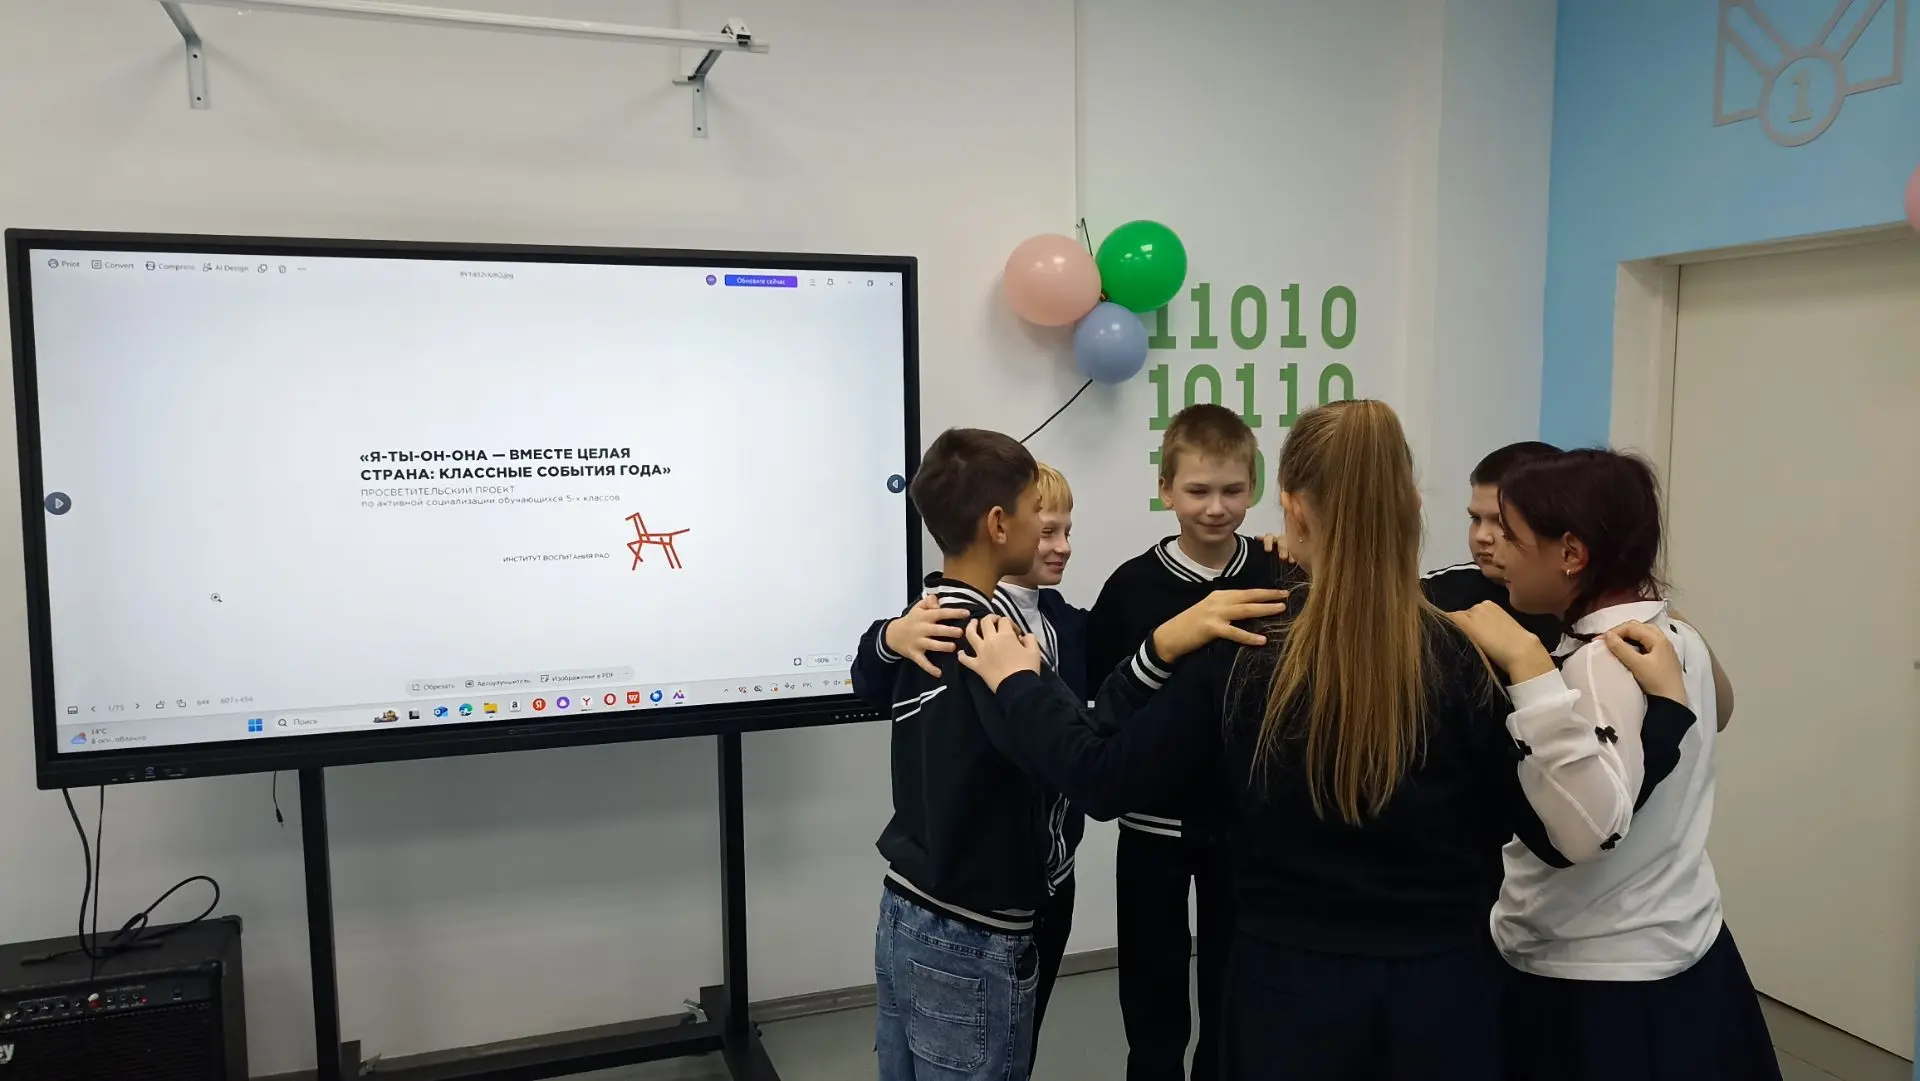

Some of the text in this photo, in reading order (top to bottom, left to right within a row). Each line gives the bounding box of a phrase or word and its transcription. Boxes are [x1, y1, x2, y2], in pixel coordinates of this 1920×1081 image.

[1787, 67, 1814, 124] 1
[61, 260, 80, 268] Print
[104, 261, 135, 269] Convert
[360, 449, 488, 462] «Я-ТЫ-ОН-ОНА
[509, 448, 573, 460] ВМЕСТЕ
[577, 447, 631, 461] ЦЕЛАЯ
[360, 464, 671, 481] СТРАНА: КЛАССНЫЕ СОБЫТИЯ ГОДА»
[361, 485, 515, 497] ПРОСВЕТИТЕЛЬСКИЙ ПРОЕКТ
[361, 500, 374, 508] по
[376, 498, 424, 507] активной
[426, 498, 495, 507] социализации
[498, 495, 564, 505] обучающихся
[583, 494, 620, 502] классов
[503, 554, 541, 563] ИНСТИТУТ
[543, 552, 593, 562] ВОСПИТАНИЯ
[293, 718, 318, 727] Поиск
